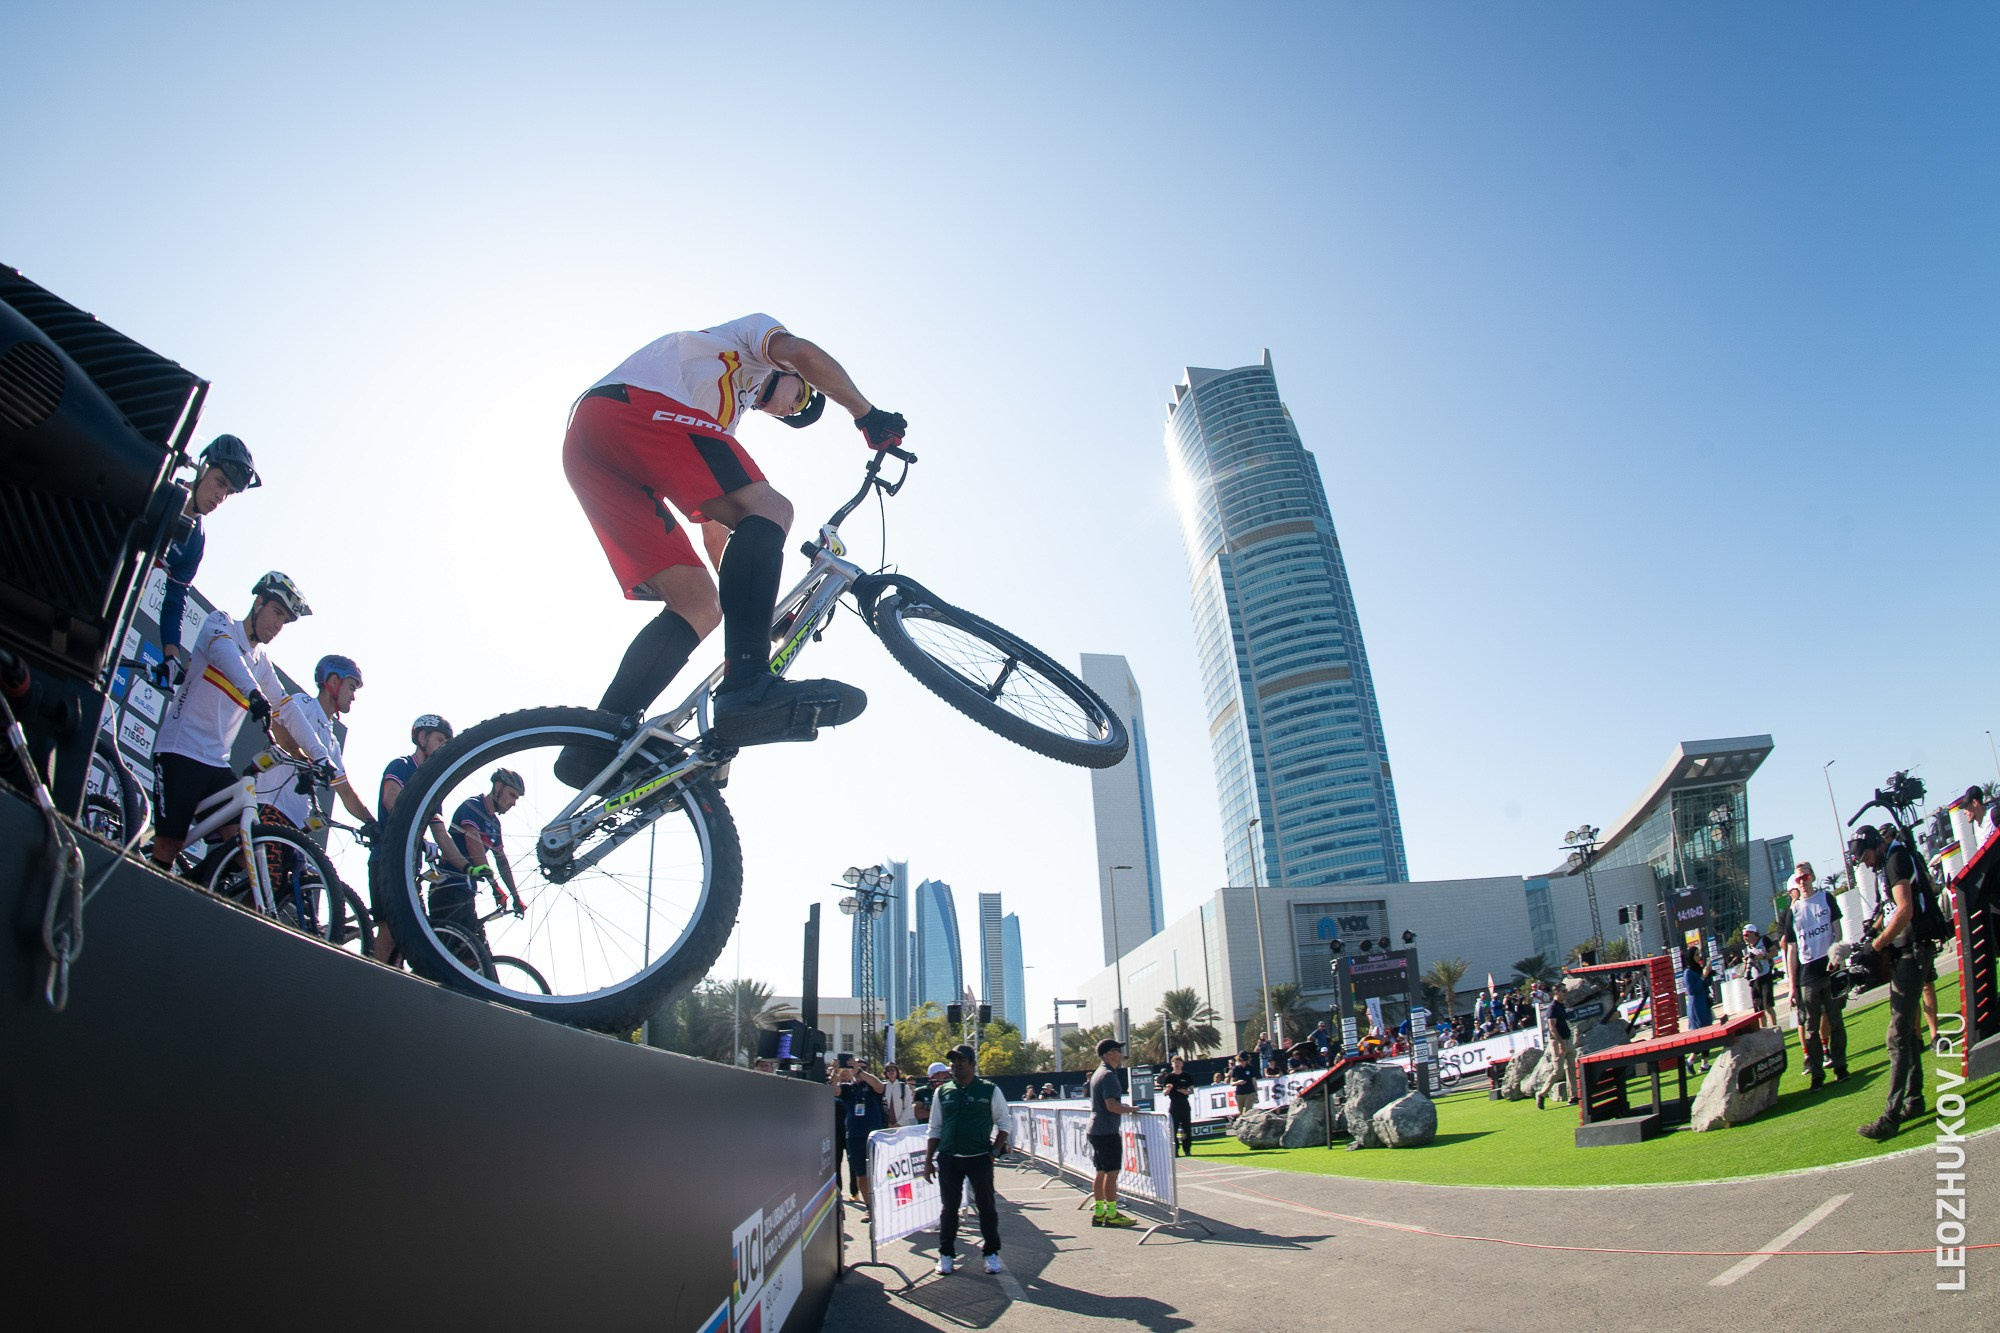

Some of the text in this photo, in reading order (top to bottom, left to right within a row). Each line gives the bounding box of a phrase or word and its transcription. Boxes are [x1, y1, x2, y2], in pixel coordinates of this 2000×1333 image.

[148, 593, 163, 614] UA
[154, 578, 202, 628] AB ABI
[123, 725, 151, 750] TISSOT
[1337, 915, 1370, 932] VOX
[1808, 923, 1829, 939] HOST
[1449, 1047, 1486, 1066] SOT
[1132, 1077, 1152, 1085] START
[1139, 1084, 1147, 1099] 1
[1192, 1126, 1211, 1135] UCI
[890, 1158, 911, 1178] UCI
[740, 1223, 761, 1295] UCI
